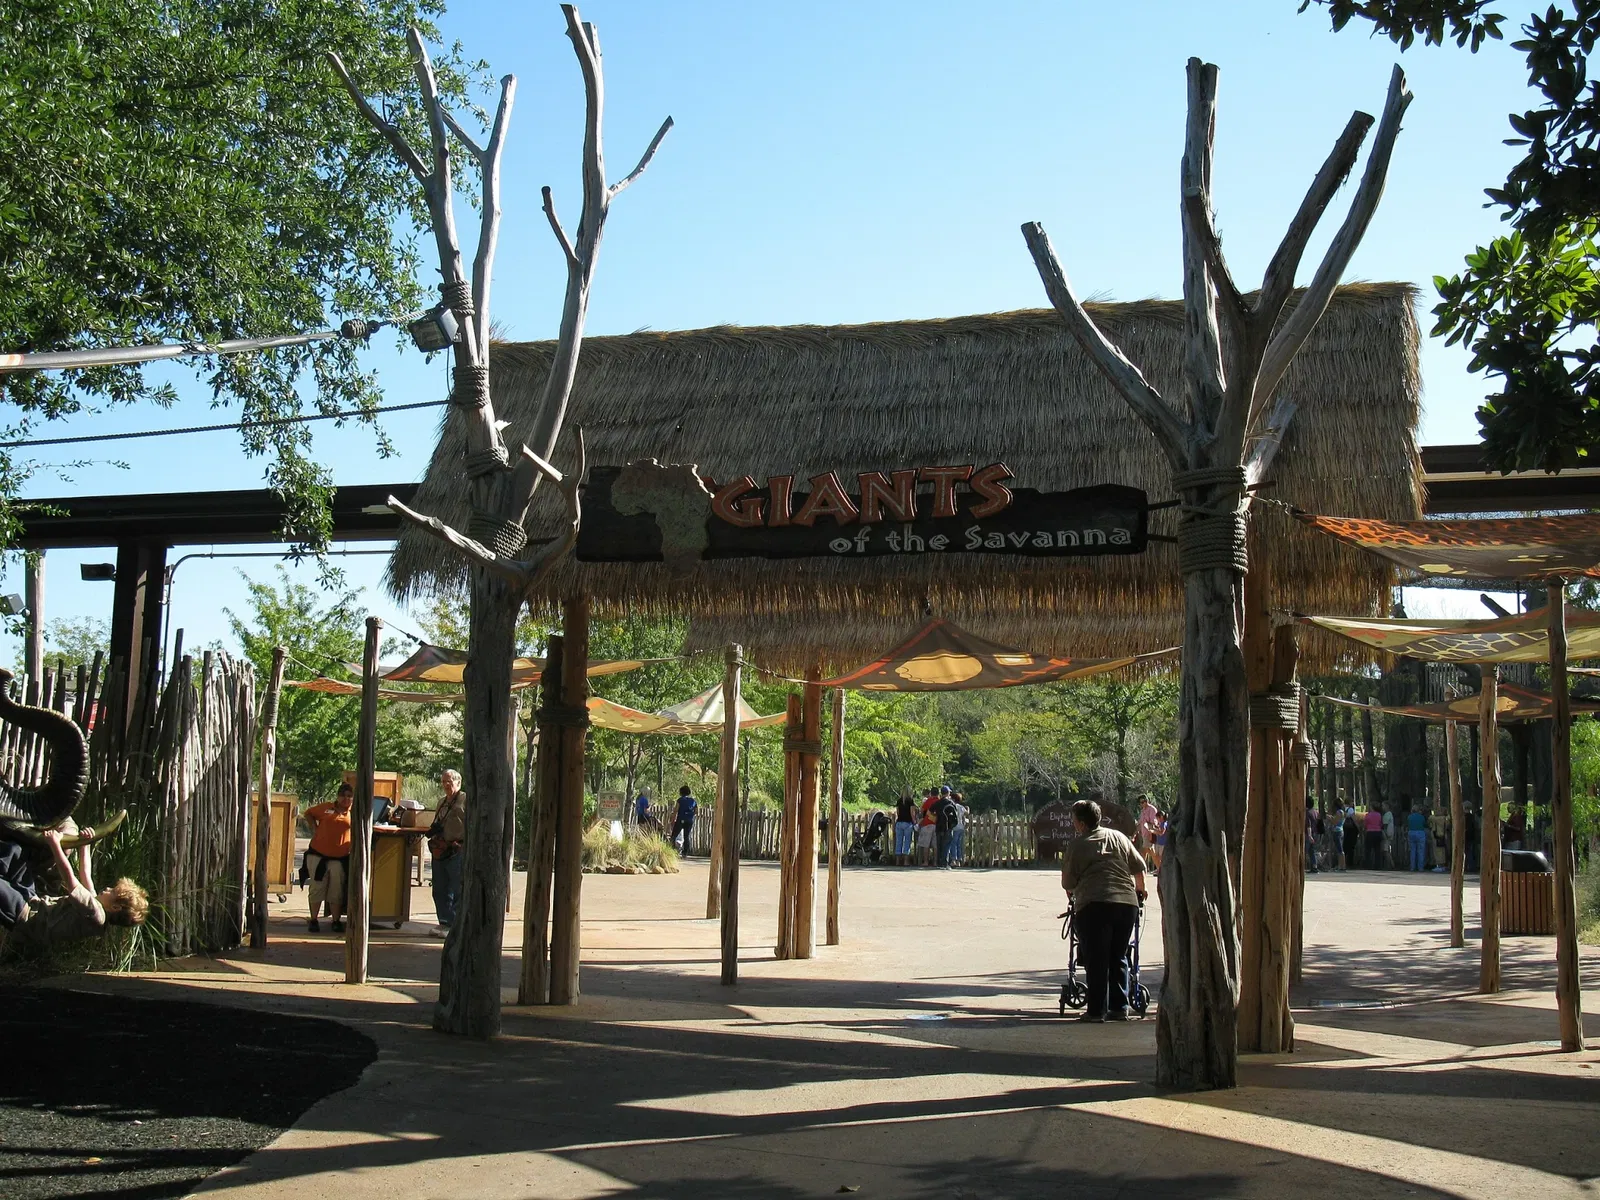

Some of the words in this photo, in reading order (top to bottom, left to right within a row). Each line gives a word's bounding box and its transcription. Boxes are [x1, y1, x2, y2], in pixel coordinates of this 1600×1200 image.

[711, 462, 1015, 527] GIANTS
[828, 525, 872, 554] of
[885, 523, 950, 553] the
[964, 524, 1132, 550] Savanna
